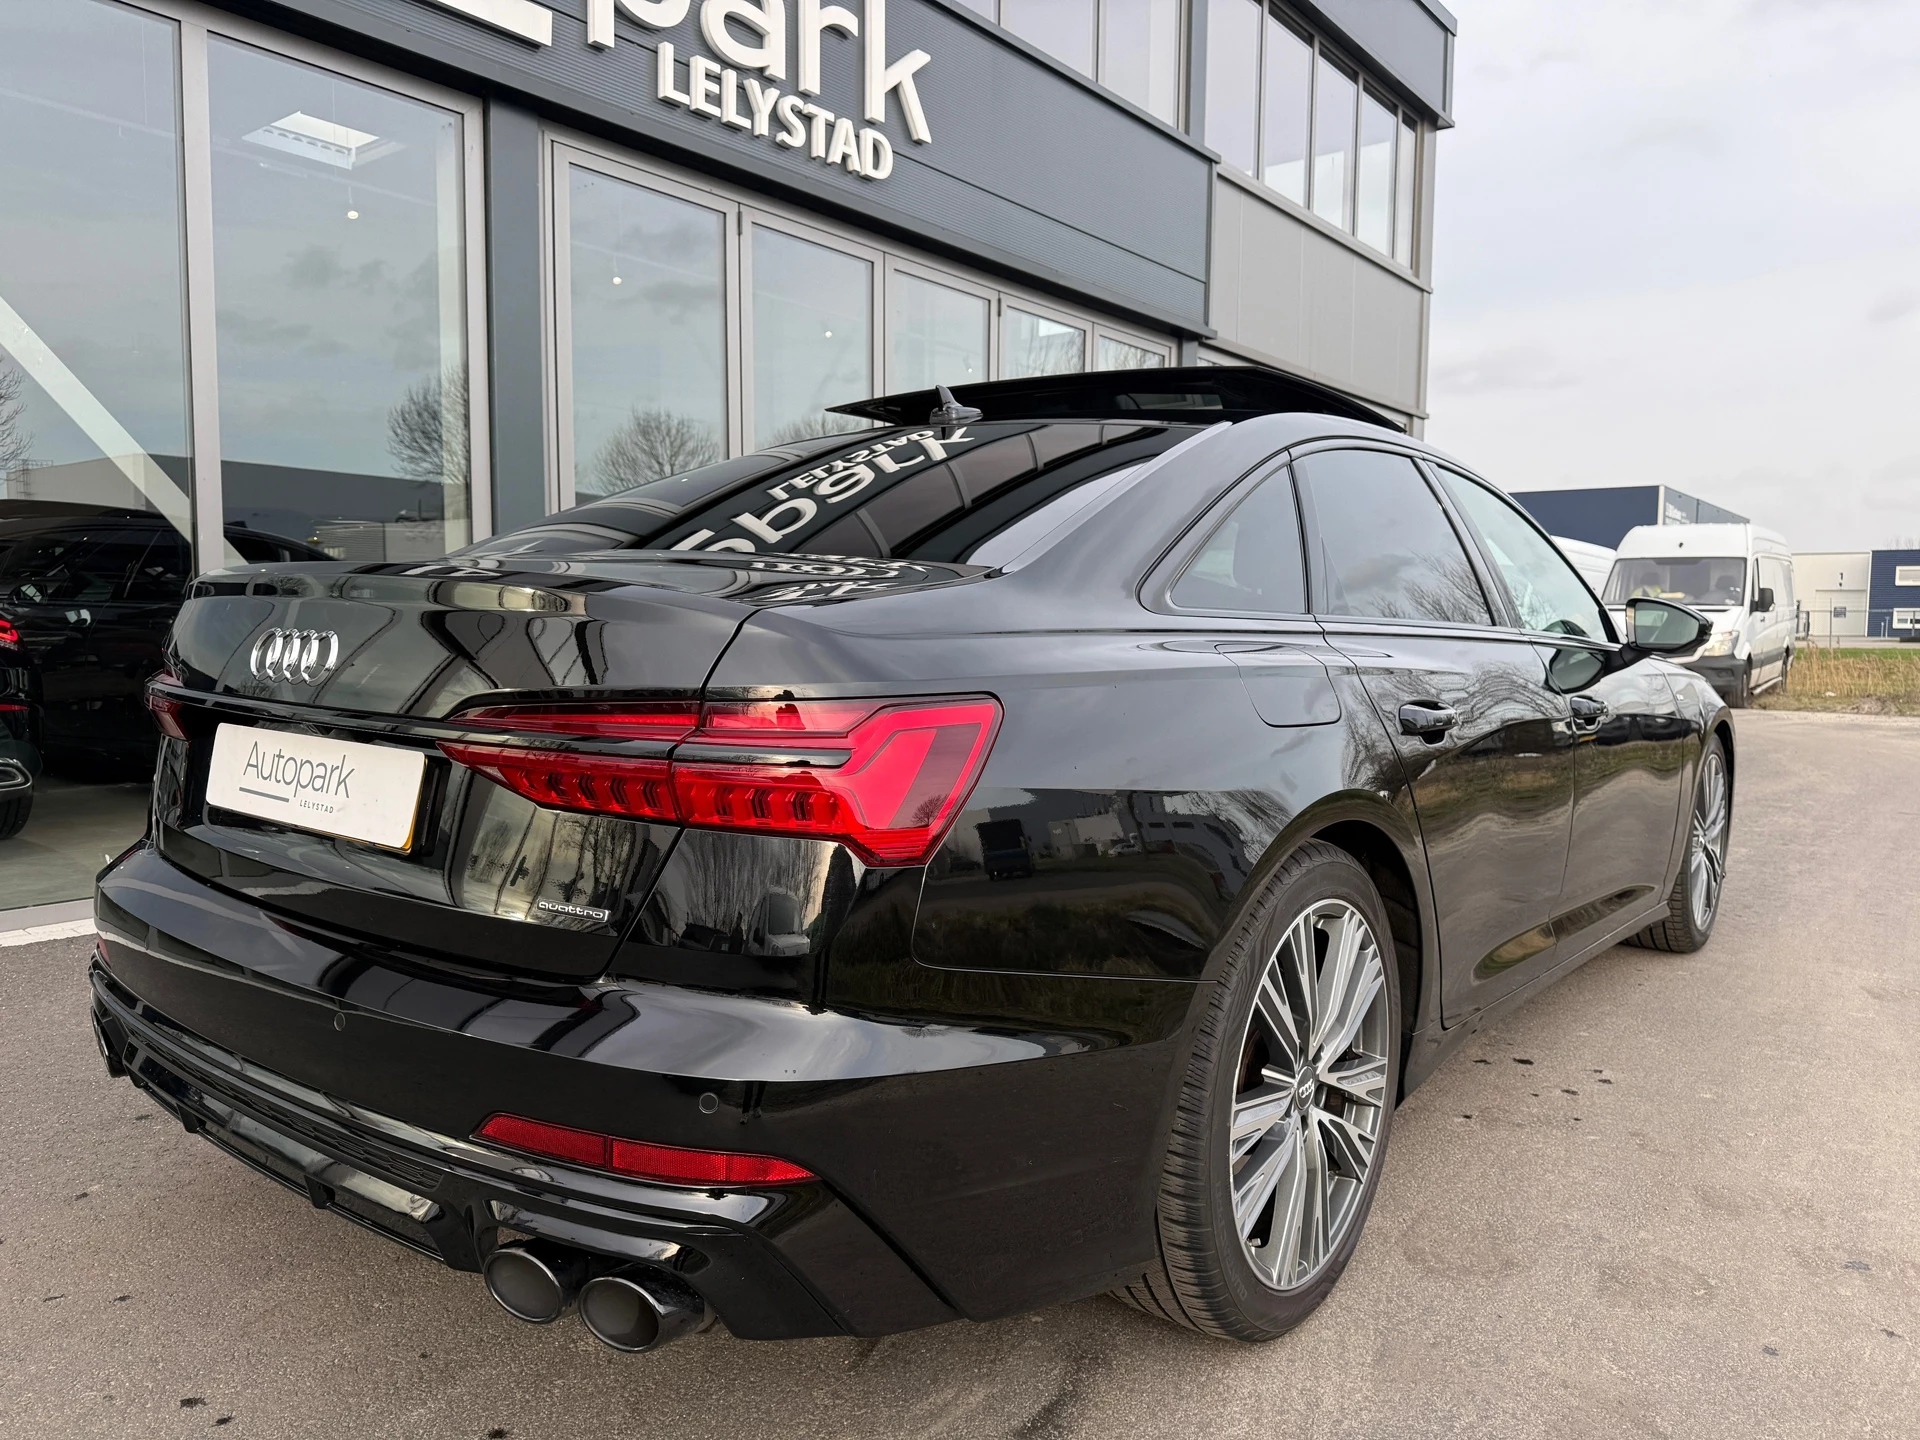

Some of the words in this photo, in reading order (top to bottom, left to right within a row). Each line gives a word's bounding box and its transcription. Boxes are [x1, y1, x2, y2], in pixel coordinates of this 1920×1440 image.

[657, 41, 894, 180] LELYSTAD
[243, 741, 355, 798] Autopark
[300, 800, 334, 814] LELYSTAD
[539, 901, 604, 919] quattro
